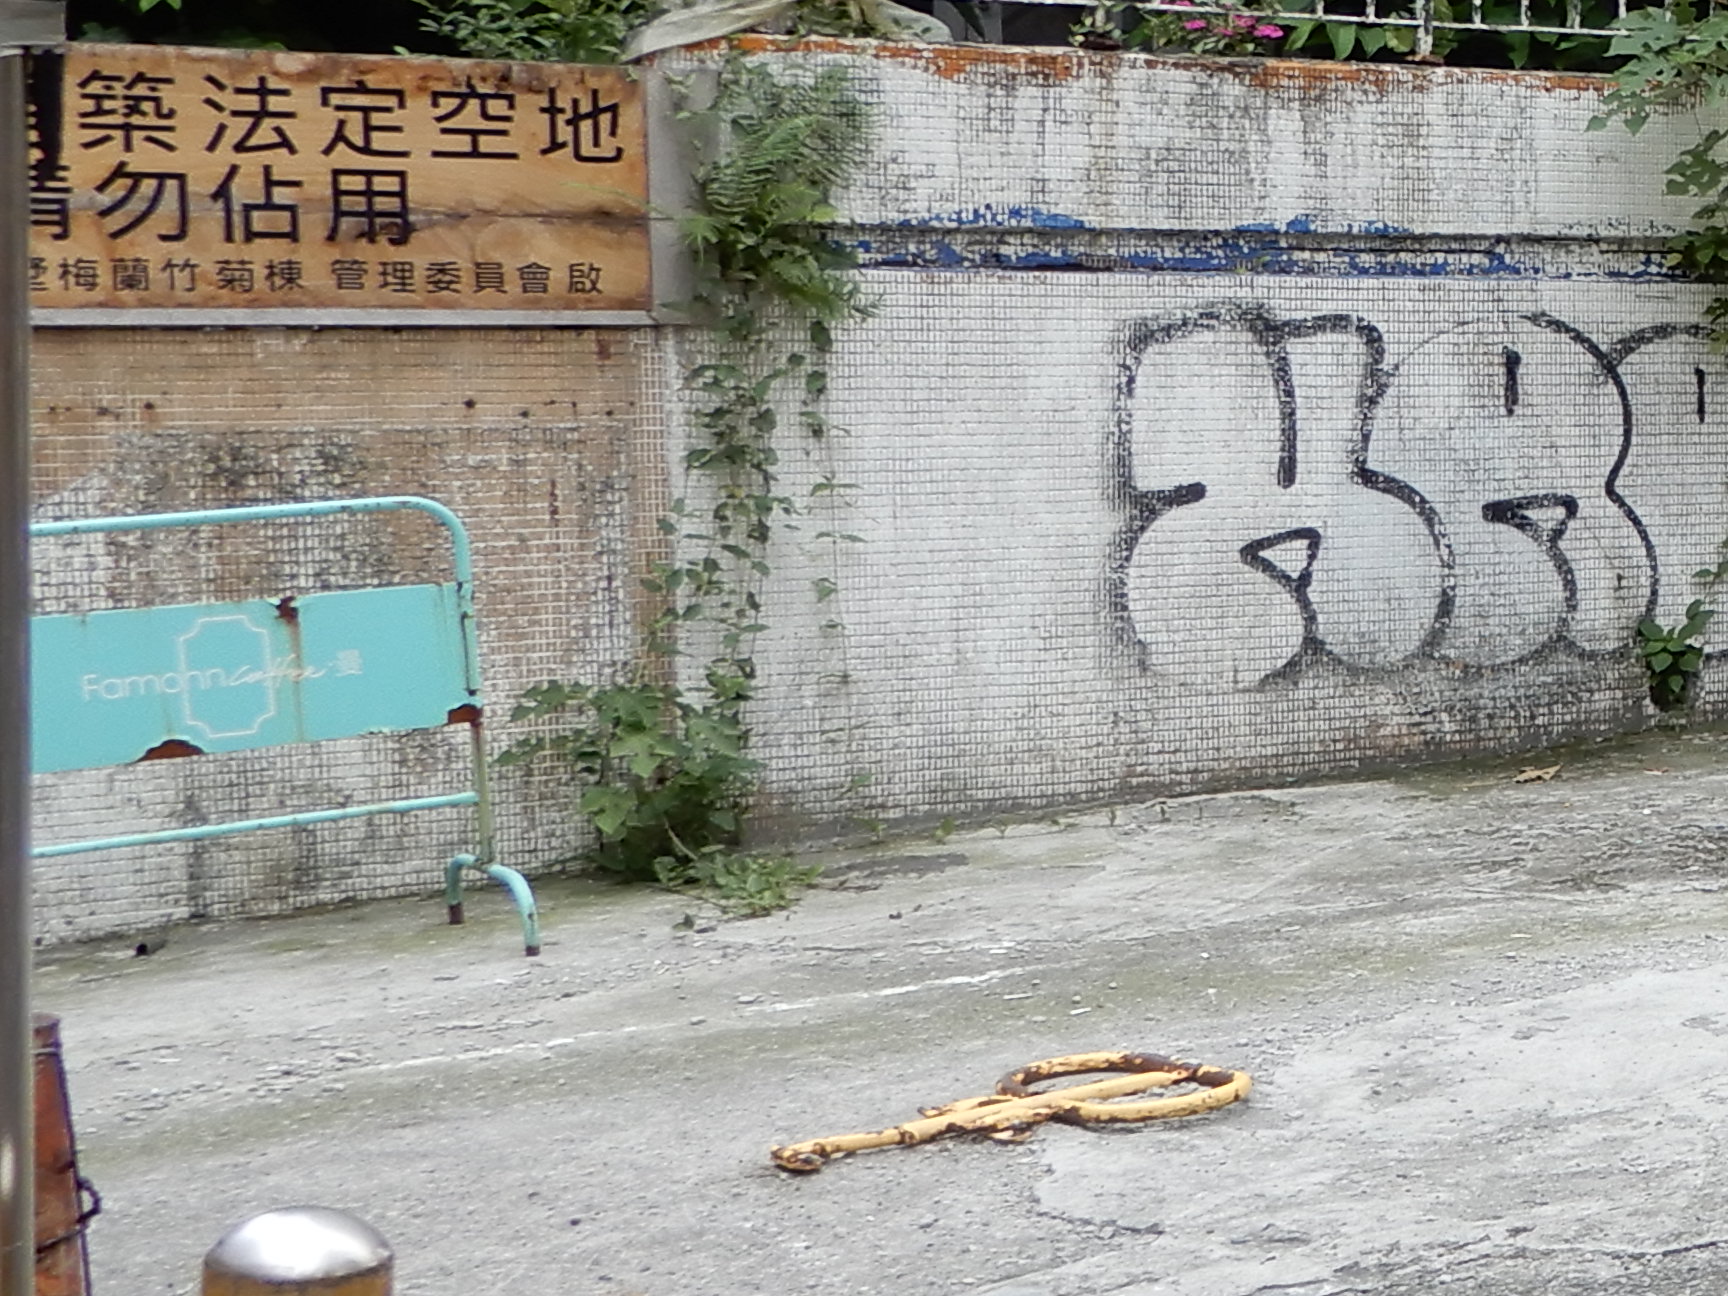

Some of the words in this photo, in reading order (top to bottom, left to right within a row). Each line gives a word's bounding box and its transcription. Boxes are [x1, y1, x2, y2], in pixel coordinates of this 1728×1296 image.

[27, 69, 624, 164] 築法定空地
